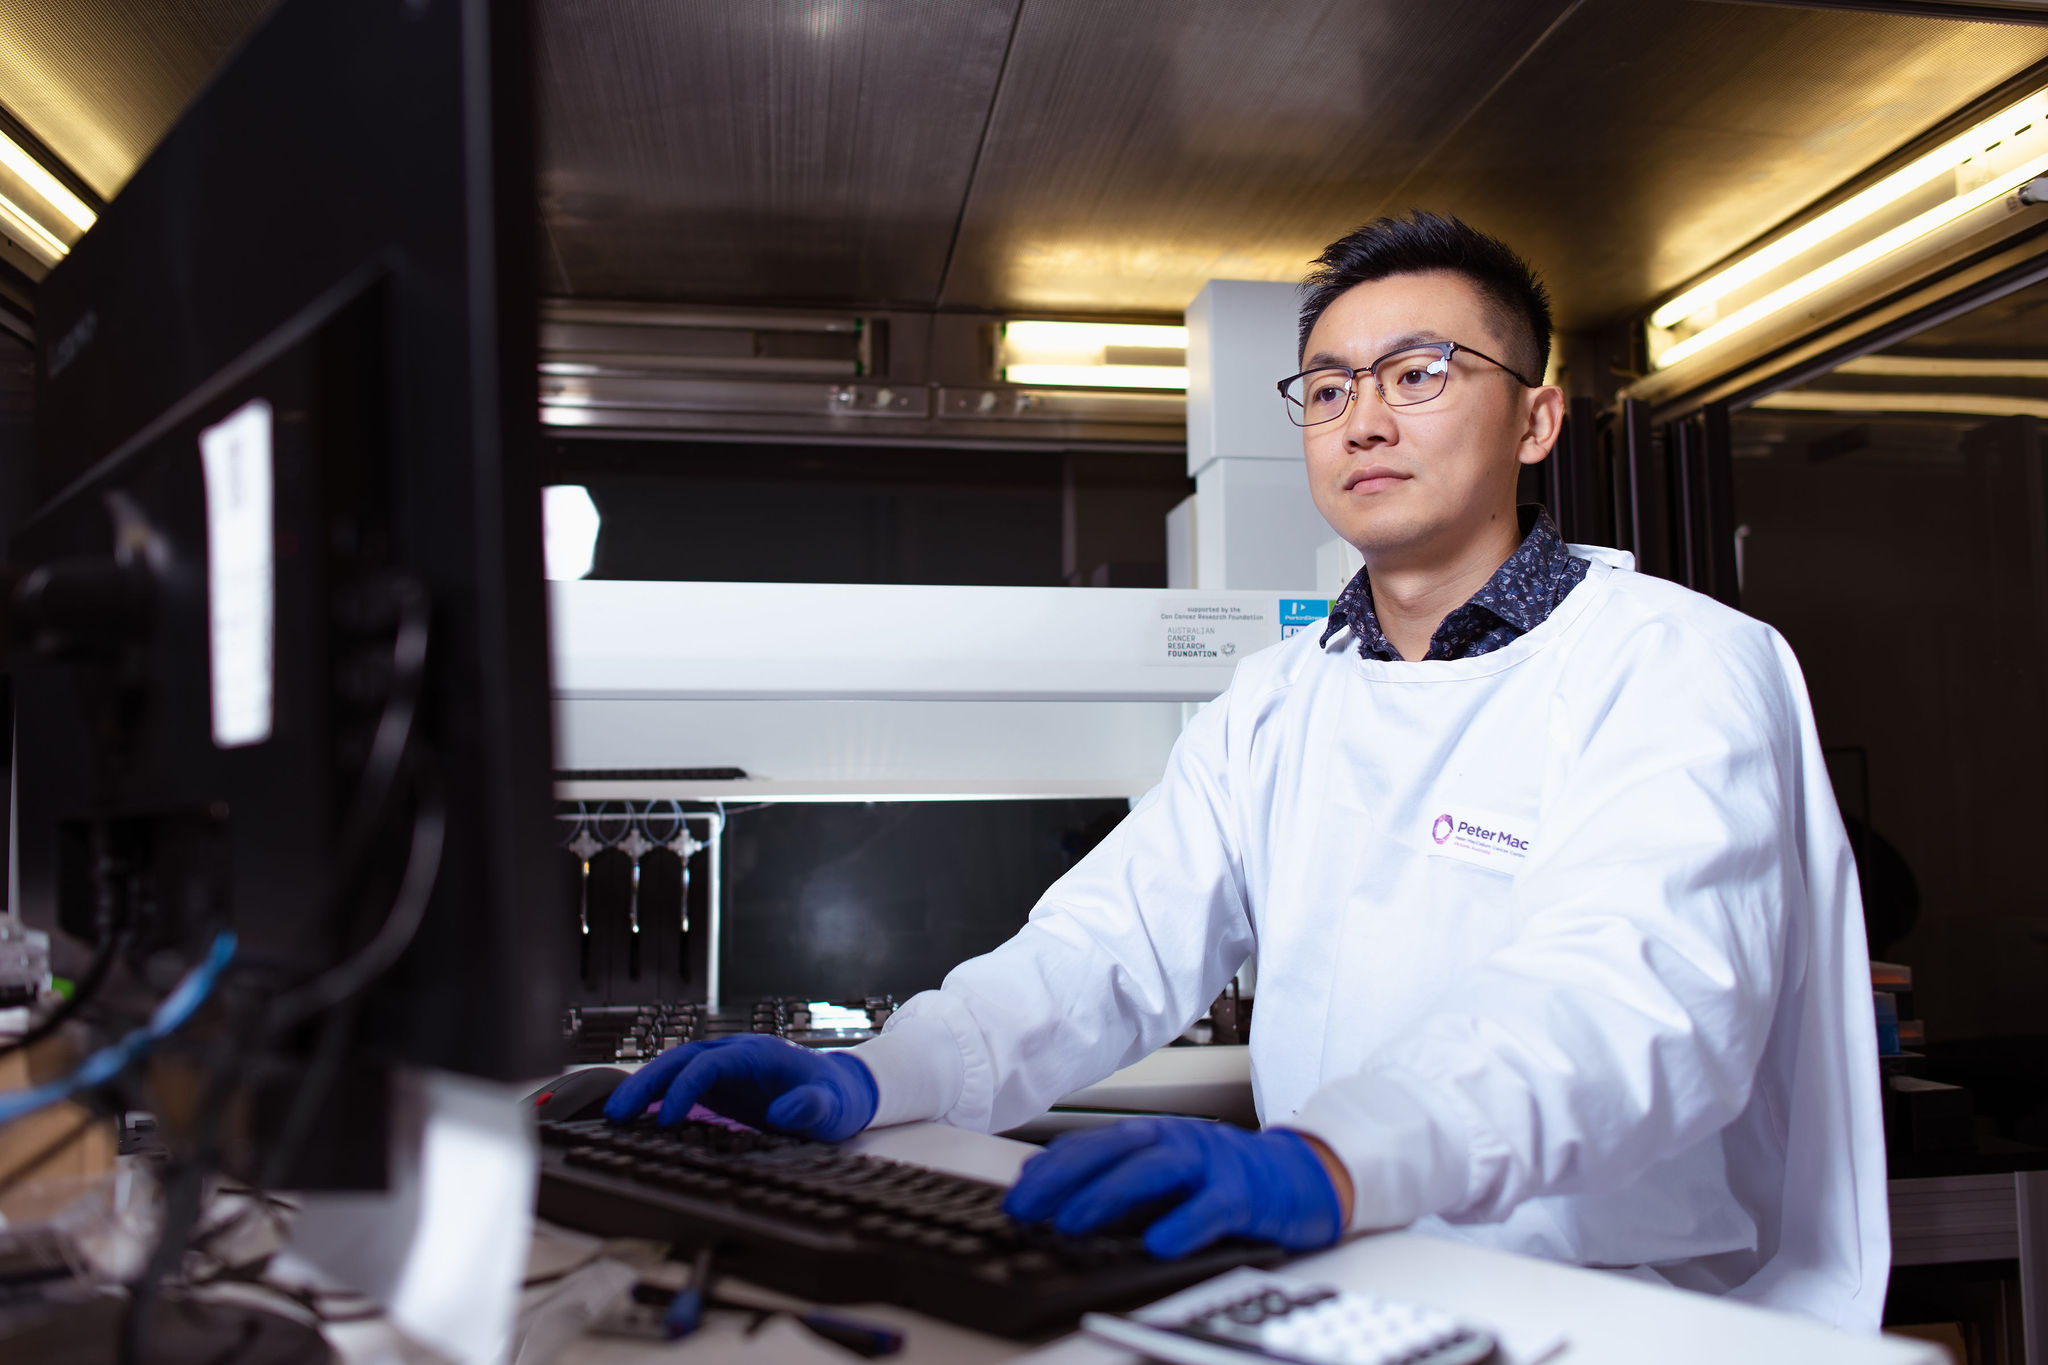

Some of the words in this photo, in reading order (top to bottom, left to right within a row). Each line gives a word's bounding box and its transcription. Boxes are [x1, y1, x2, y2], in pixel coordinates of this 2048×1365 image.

[1167, 627, 1215, 635] AUSTRALIAN
[1458, 821, 1496, 840] Peter
[1497, 831, 1529, 850] Mac
